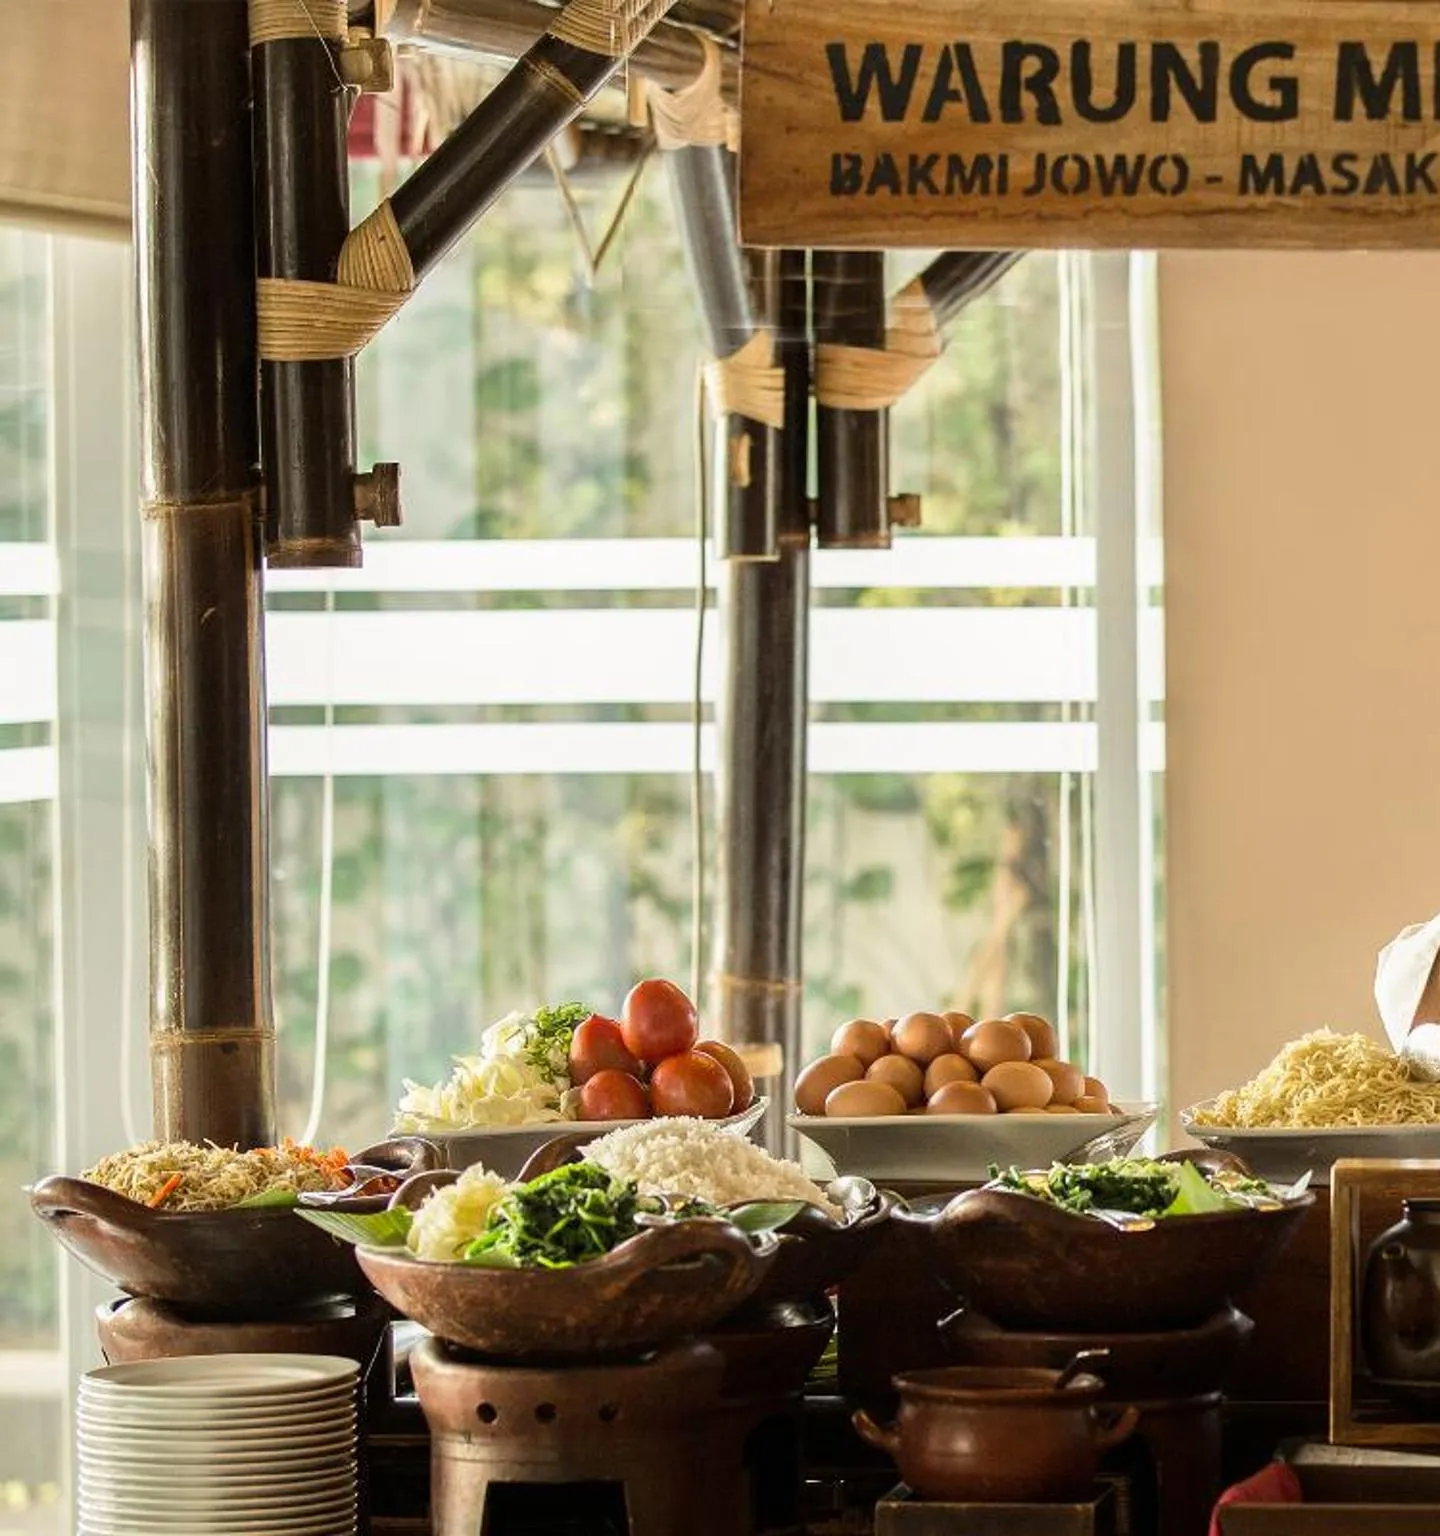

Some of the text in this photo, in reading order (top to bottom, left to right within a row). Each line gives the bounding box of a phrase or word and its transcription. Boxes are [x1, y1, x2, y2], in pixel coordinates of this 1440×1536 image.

[825, 39, 1300, 126] WARUNG
[828, 152, 1009, 199] BAKMI
[1021, 153, 1191, 198] JOWO
